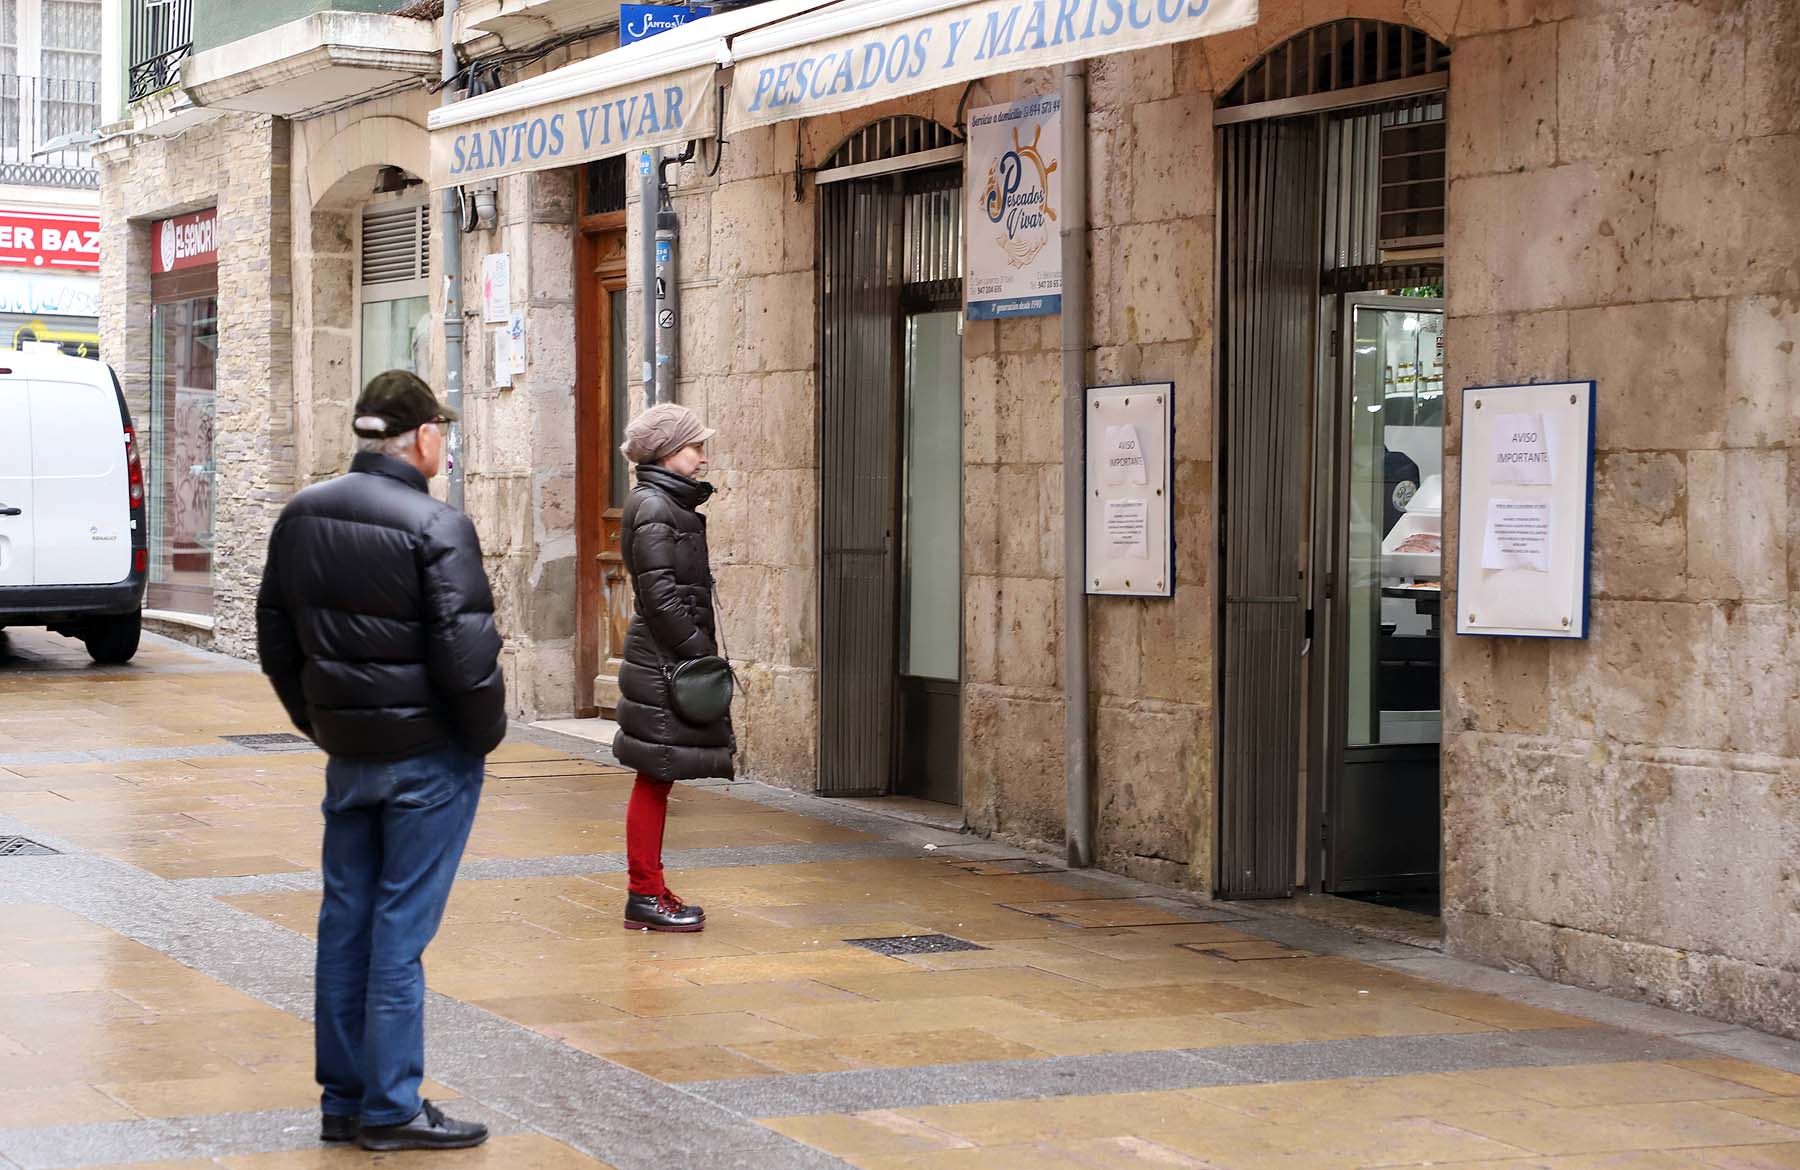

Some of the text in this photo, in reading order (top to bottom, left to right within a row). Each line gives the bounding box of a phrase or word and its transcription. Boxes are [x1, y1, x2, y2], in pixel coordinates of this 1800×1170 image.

[748, 27, 933, 112] PESCADOS
[942, 18, 971, 68] Y
[449, 86, 684, 174] SANTOS VIVAR
[987, 151, 1045, 223] Pescados
[0, 226, 35, 249] ER
[1007, 207, 1045, 240] Vivar
[1118, 440, 1136, 450] AVISO
[1512, 432, 1537, 443] AVISO
